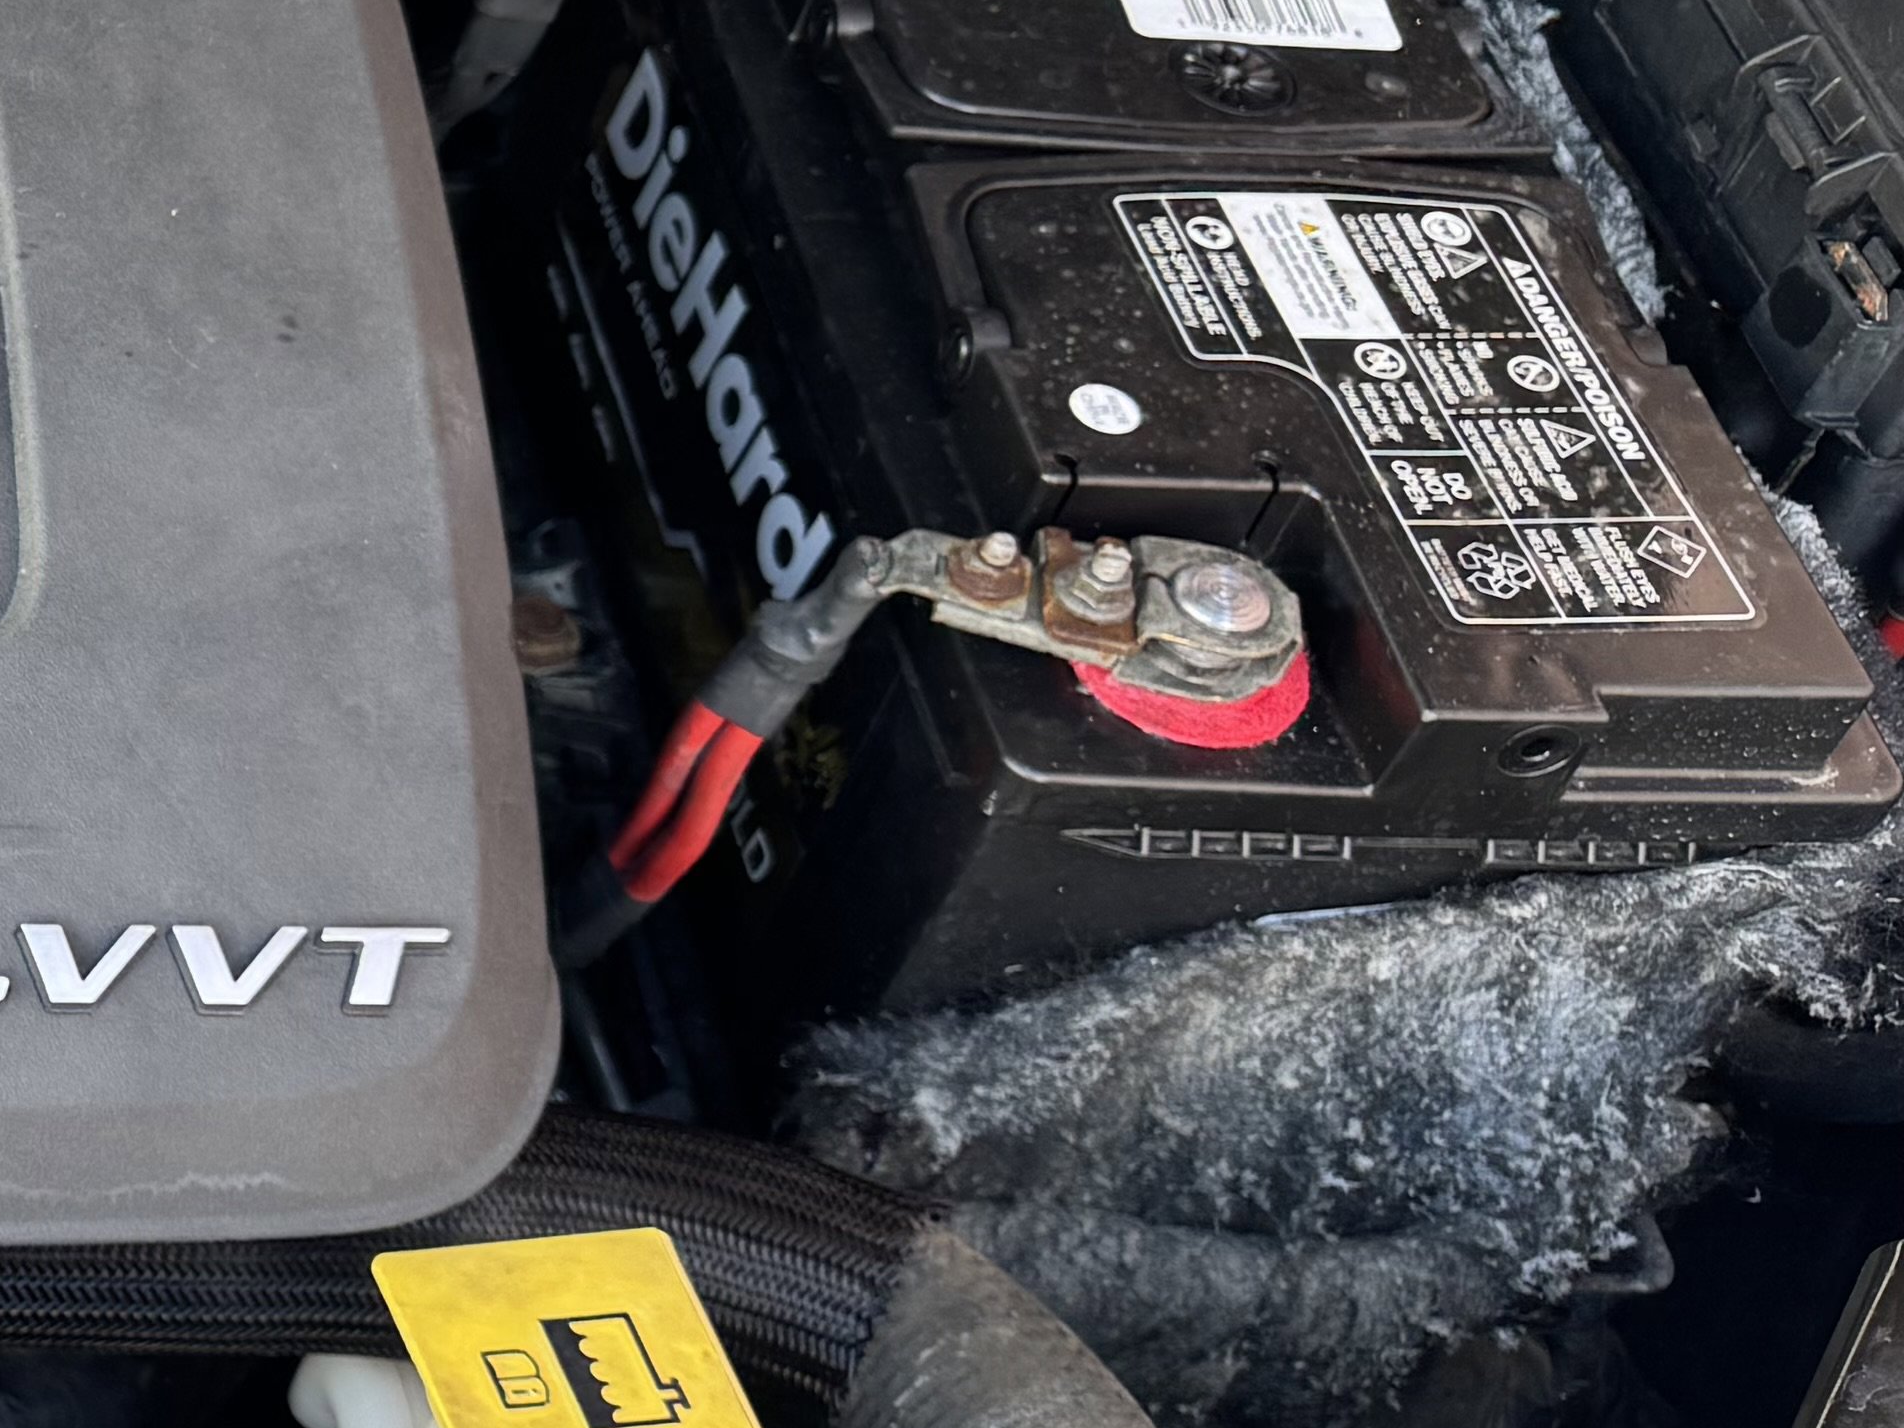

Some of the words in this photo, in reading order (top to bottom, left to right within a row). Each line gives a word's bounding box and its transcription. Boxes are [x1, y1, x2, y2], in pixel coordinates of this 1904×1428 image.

[606, 47, 836, 600] DieHard
[1517, 278, 1645, 460] DANGER/POISON
[1389, 460, 1434, 515] OPEN.
[1416, 467, 1452, 504] NOT
[1441, 473, 1474, 499] DO
[1540, 529, 1567, 554] GET
[1629, 569, 1661, 603] EYES
[18, 922, 453, 1016] VVT
